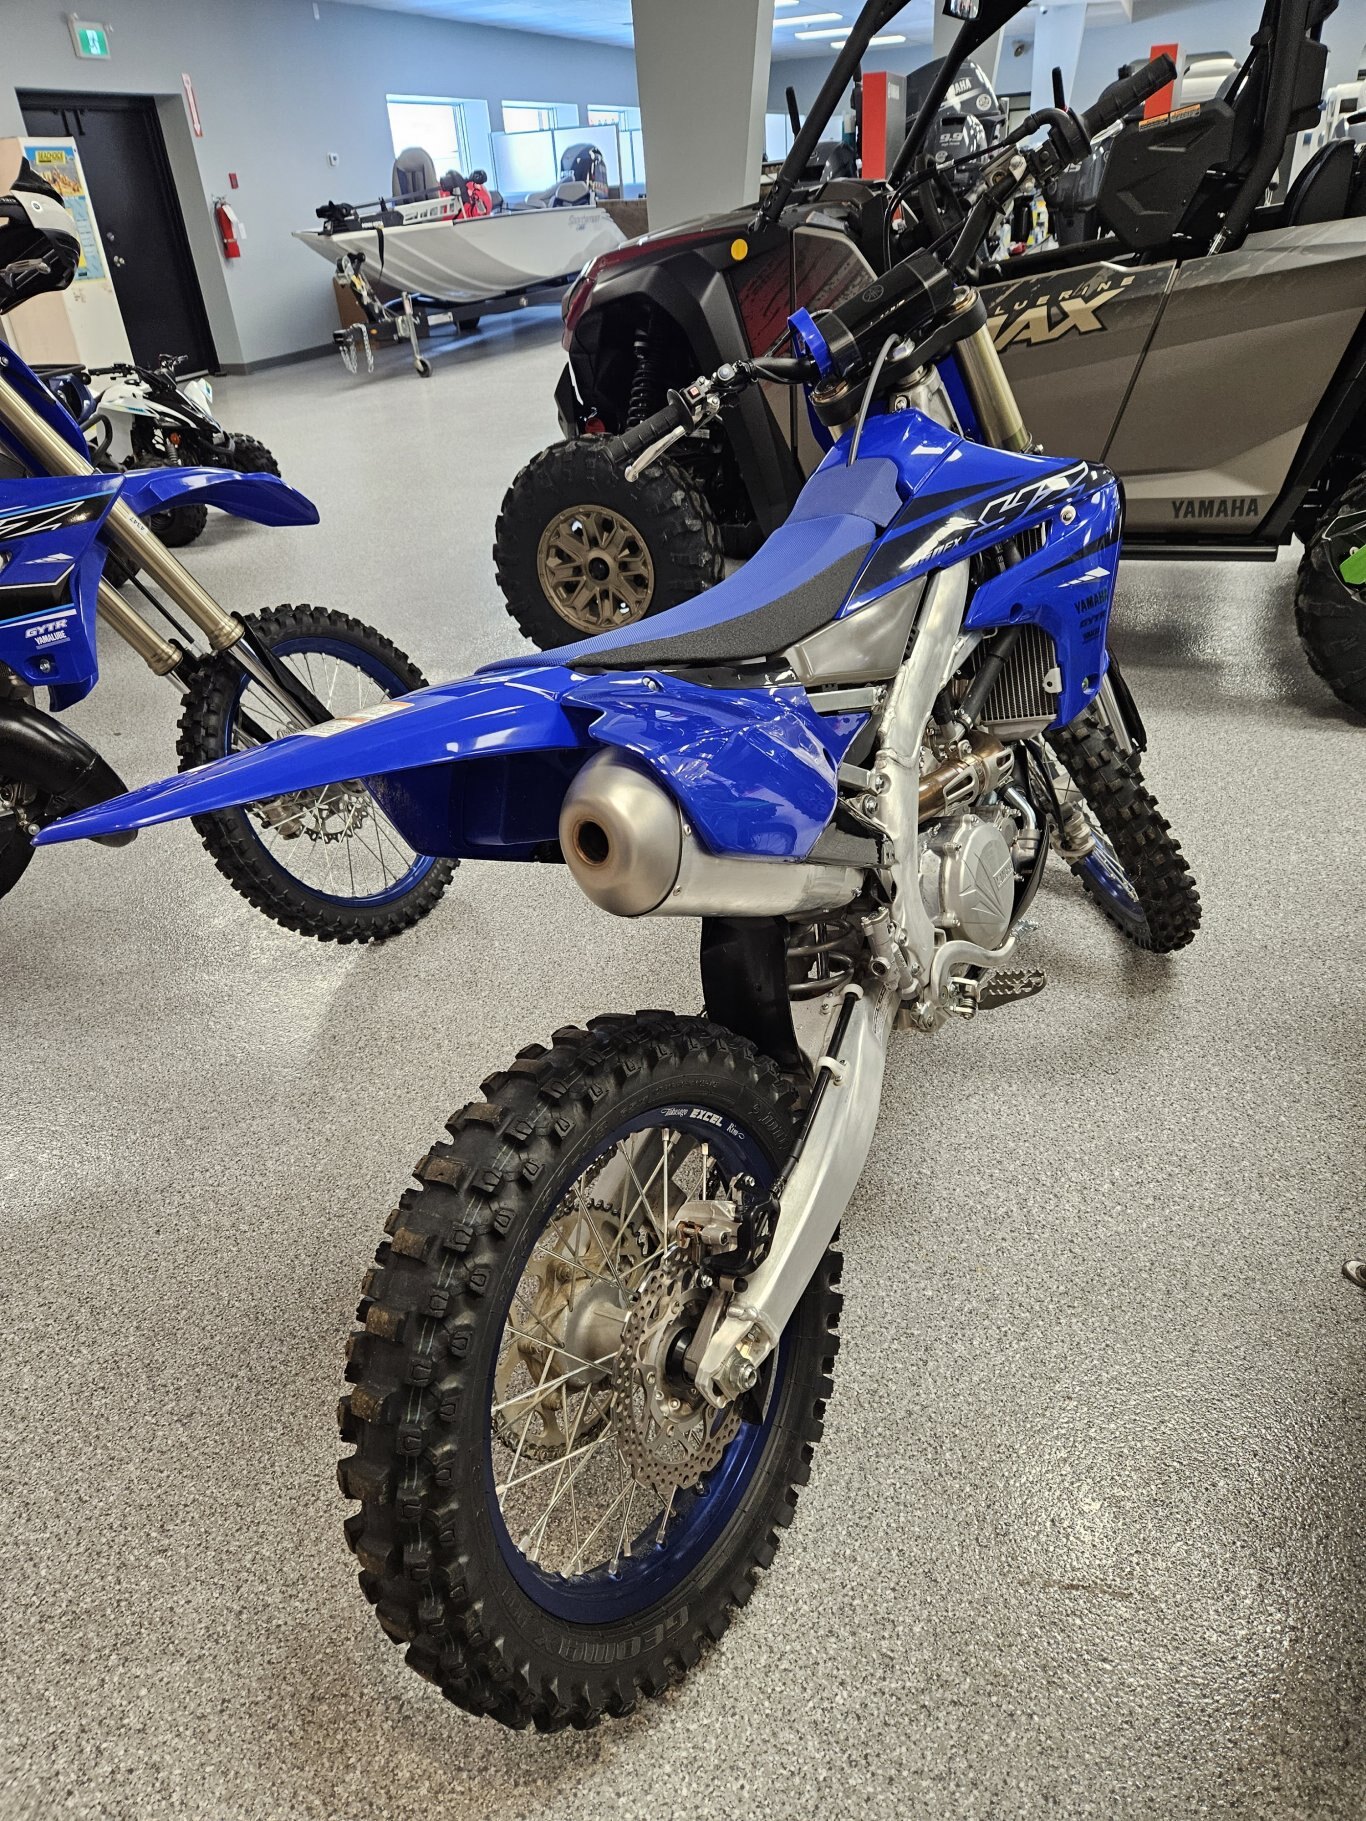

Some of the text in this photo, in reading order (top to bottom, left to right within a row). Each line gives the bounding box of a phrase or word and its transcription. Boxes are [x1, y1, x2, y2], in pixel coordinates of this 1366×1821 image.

[939, 132, 964, 144] 9.9
[1171, 498, 1259, 519] YAMAHA
[25, 618, 68, 639] GYTR
[34, 630, 67, 645] YAMALUBE
[689, 1108, 724, 1127] EXCEL
[726, 1122, 743, 1139] Rim
